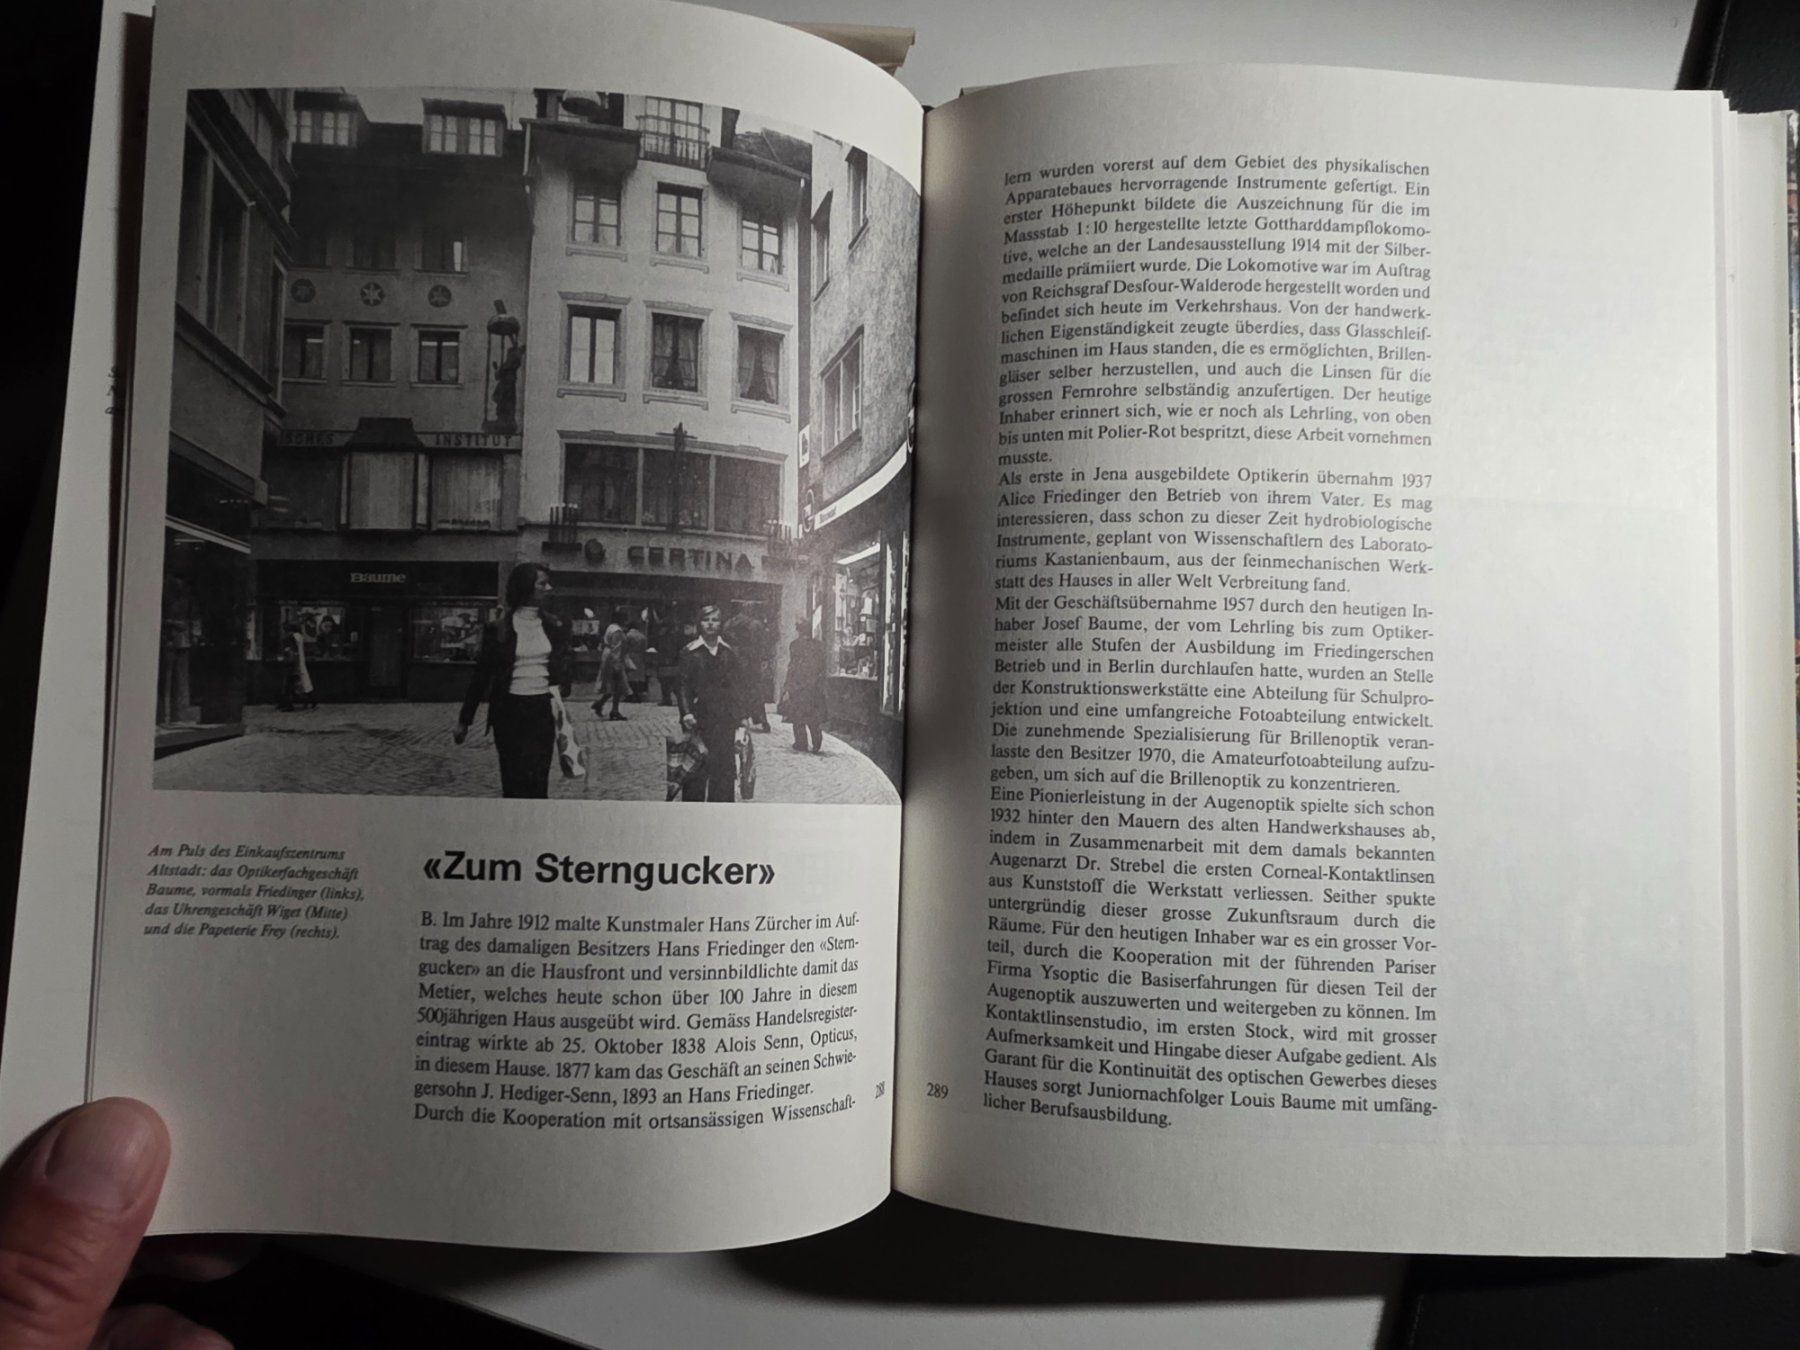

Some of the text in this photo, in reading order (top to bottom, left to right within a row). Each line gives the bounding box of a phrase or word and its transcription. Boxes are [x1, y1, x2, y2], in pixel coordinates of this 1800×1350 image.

[1005, 175, 1430, 206] Apparatebaues hervorragende Instrumente gefertigt. Ein
[1003, 237, 1430, 265] tive, welche an der Landesausstellung 1914 mit der Silber-
[1000, 340, 1431, 365] maschinen im Haus standen, die es ermöglichten, Brillen-
[435, 433, 512, 447] INSTITUT
[998, 424, 1431, 446] bis unten mit Polier-Rot bespritzt, diese Arbeit vornehmen
[996, 509, 1432, 532] interessieren, dass schon zu dieser Zeit hydrobiologische
[350, 572, 407, 585] Baume
[995, 594, 1433, 619] Mit der Geschäftsübernahme 1957 durch den heutigen In-
[992, 679, 1434, 707] der Konstruktionswerkstätte eine Abteilung für Schulpro-
[990, 785, 1434, 816] Eine Pionierleistung in der Augenoptik spielte sich schon
[147, 843, 346, 861] Am Puls des Einkaufszentrums
[146, 864, 359, 883] Altstadt: das Optikerfachgeschäft
[423, 850, 775, 892] «Zum Sterngucker»
[989, 852, 1435, 884] Augenarzt Dr. Strebel die ersten Corneal-Kontaktlinsen
[145, 883, 364, 902] Baume, vormals Friedinger (links),
[144, 902, 348, 922] das Uhrengeschäft Wiget (Mitte)
[420, 910, 859, 933] B. Im Jahre 1912 malte Kunstmaler Hans Zürcher im Auf-
[143, 922, 340, 941] und die Papeterie Frey (rechts).
[419, 936, 450, 955] trag
[454, 936, 482, 953] des
[486, 937, 571, 958] damaligen
[577, 940, 651, 957] Besitzers
[657, 940, 700, 957] Hans
[707, 940, 786, 958] Friedinger
[790, 938, 815, 954] den
[987, 938, 1437, 975] teil, durch die Kooperation mit der führenden Pariser
[418, 982, 857, 1006] Metier, welches heute schon über 100 Jahre in diesem
[415, 1028, 857, 1055] eintrag wirkte ab 25. Oktober 1838 Alois Senn, Opticus,
[985, 1026, 1437, 1068] Aufmerksamkeit und Hingabe dieser Aufgabe gedient. Als
[413, 1081, 814, 1107] gersohn J. Hediger-Senn, 1893 an Hans Friedinger.
[926, 1081, 949, 1100] 289
